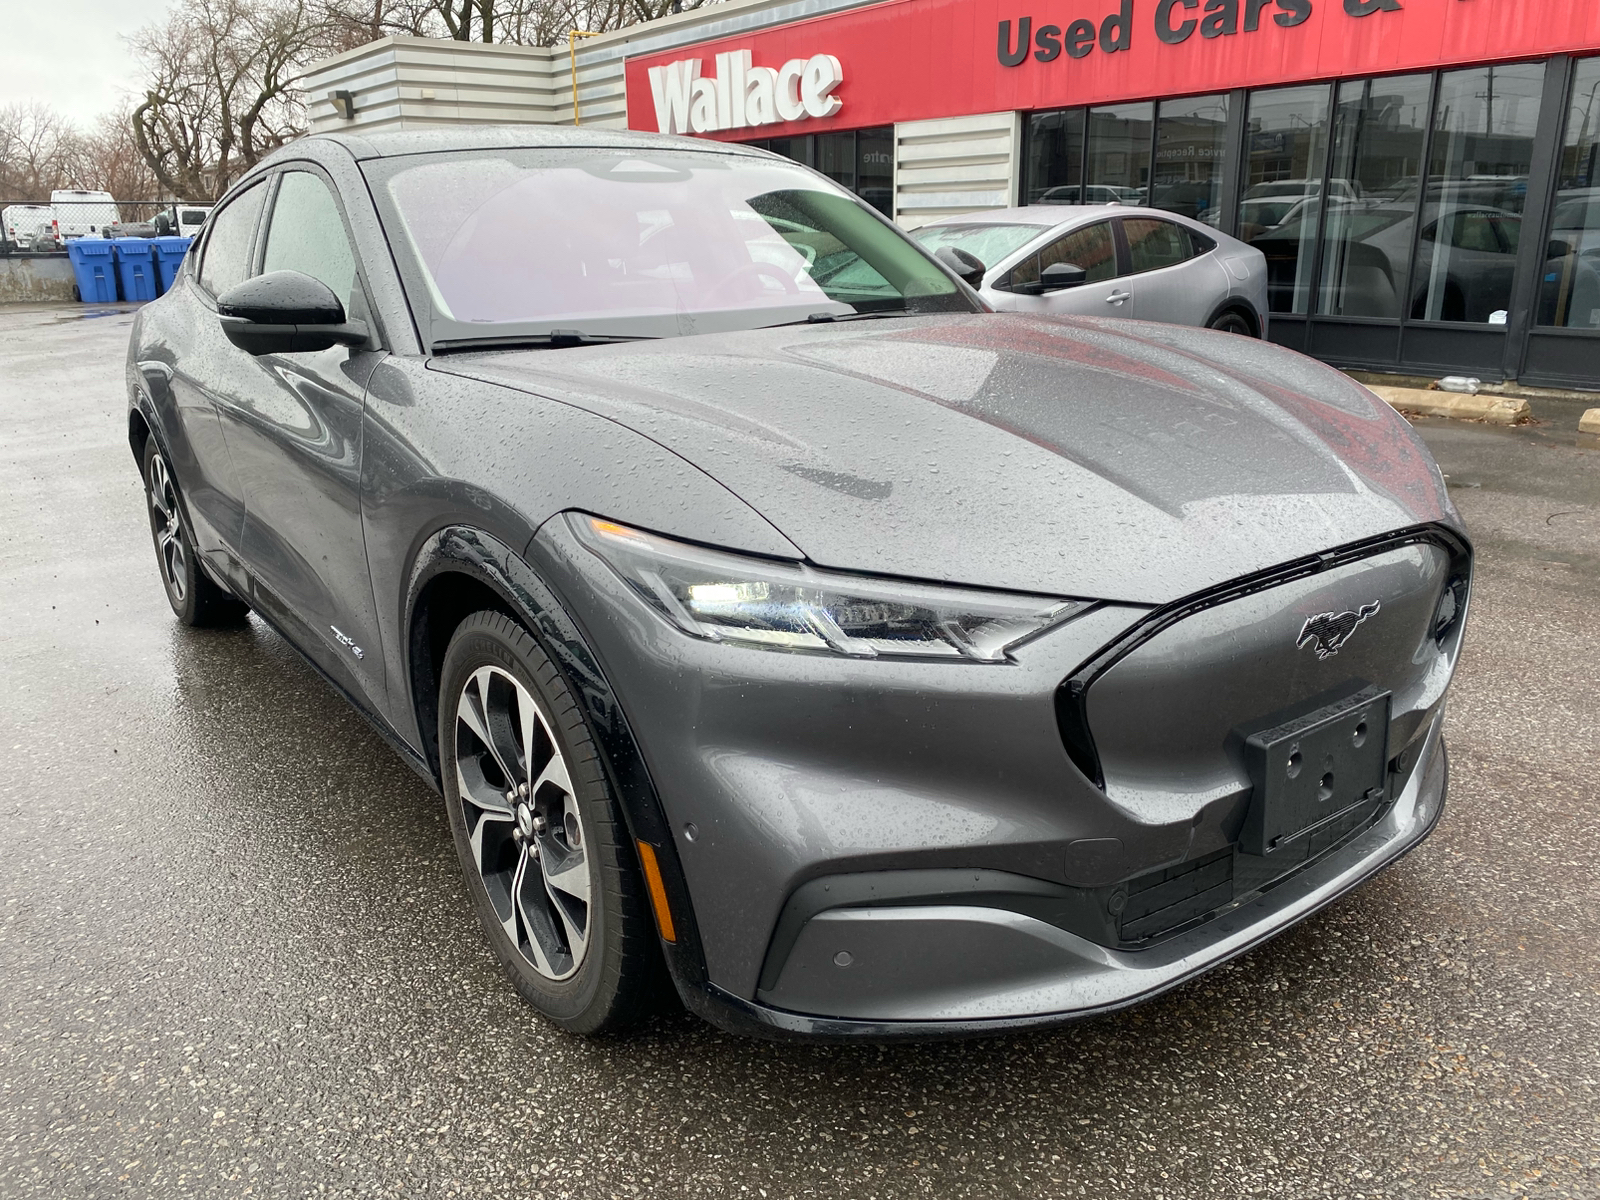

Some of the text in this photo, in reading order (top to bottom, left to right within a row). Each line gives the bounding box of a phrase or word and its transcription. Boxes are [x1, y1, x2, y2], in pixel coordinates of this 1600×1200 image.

[997, 0, 1312, 67] Used Cars
[648, 49, 843, 134] Wallace
